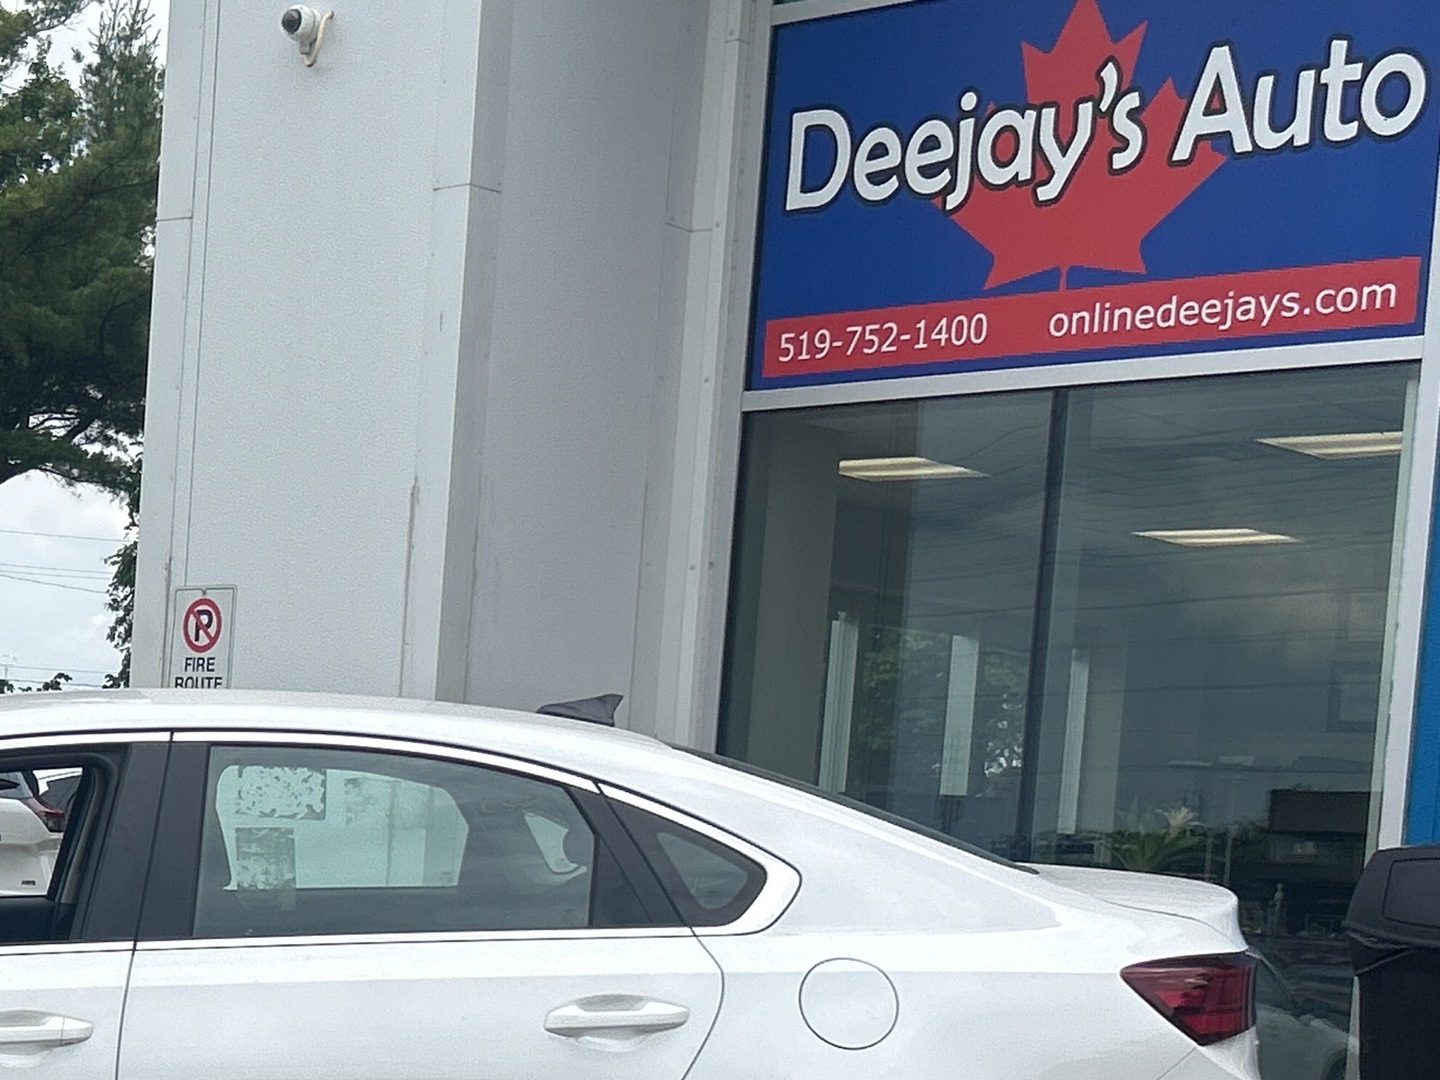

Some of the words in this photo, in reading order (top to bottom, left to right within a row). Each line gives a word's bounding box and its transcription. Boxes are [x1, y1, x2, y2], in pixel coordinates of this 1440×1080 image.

[784, 60, 1141, 211] Deejay's
[1171, 38, 1427, 164] Auto
[777, 312, 989, 363] 519-752-1400
[1048, 280, 1397, 337] onlinedeejays.com
[174, 676, 223, 689] ROUTE
[184, 657, 216, 673] FIRE
